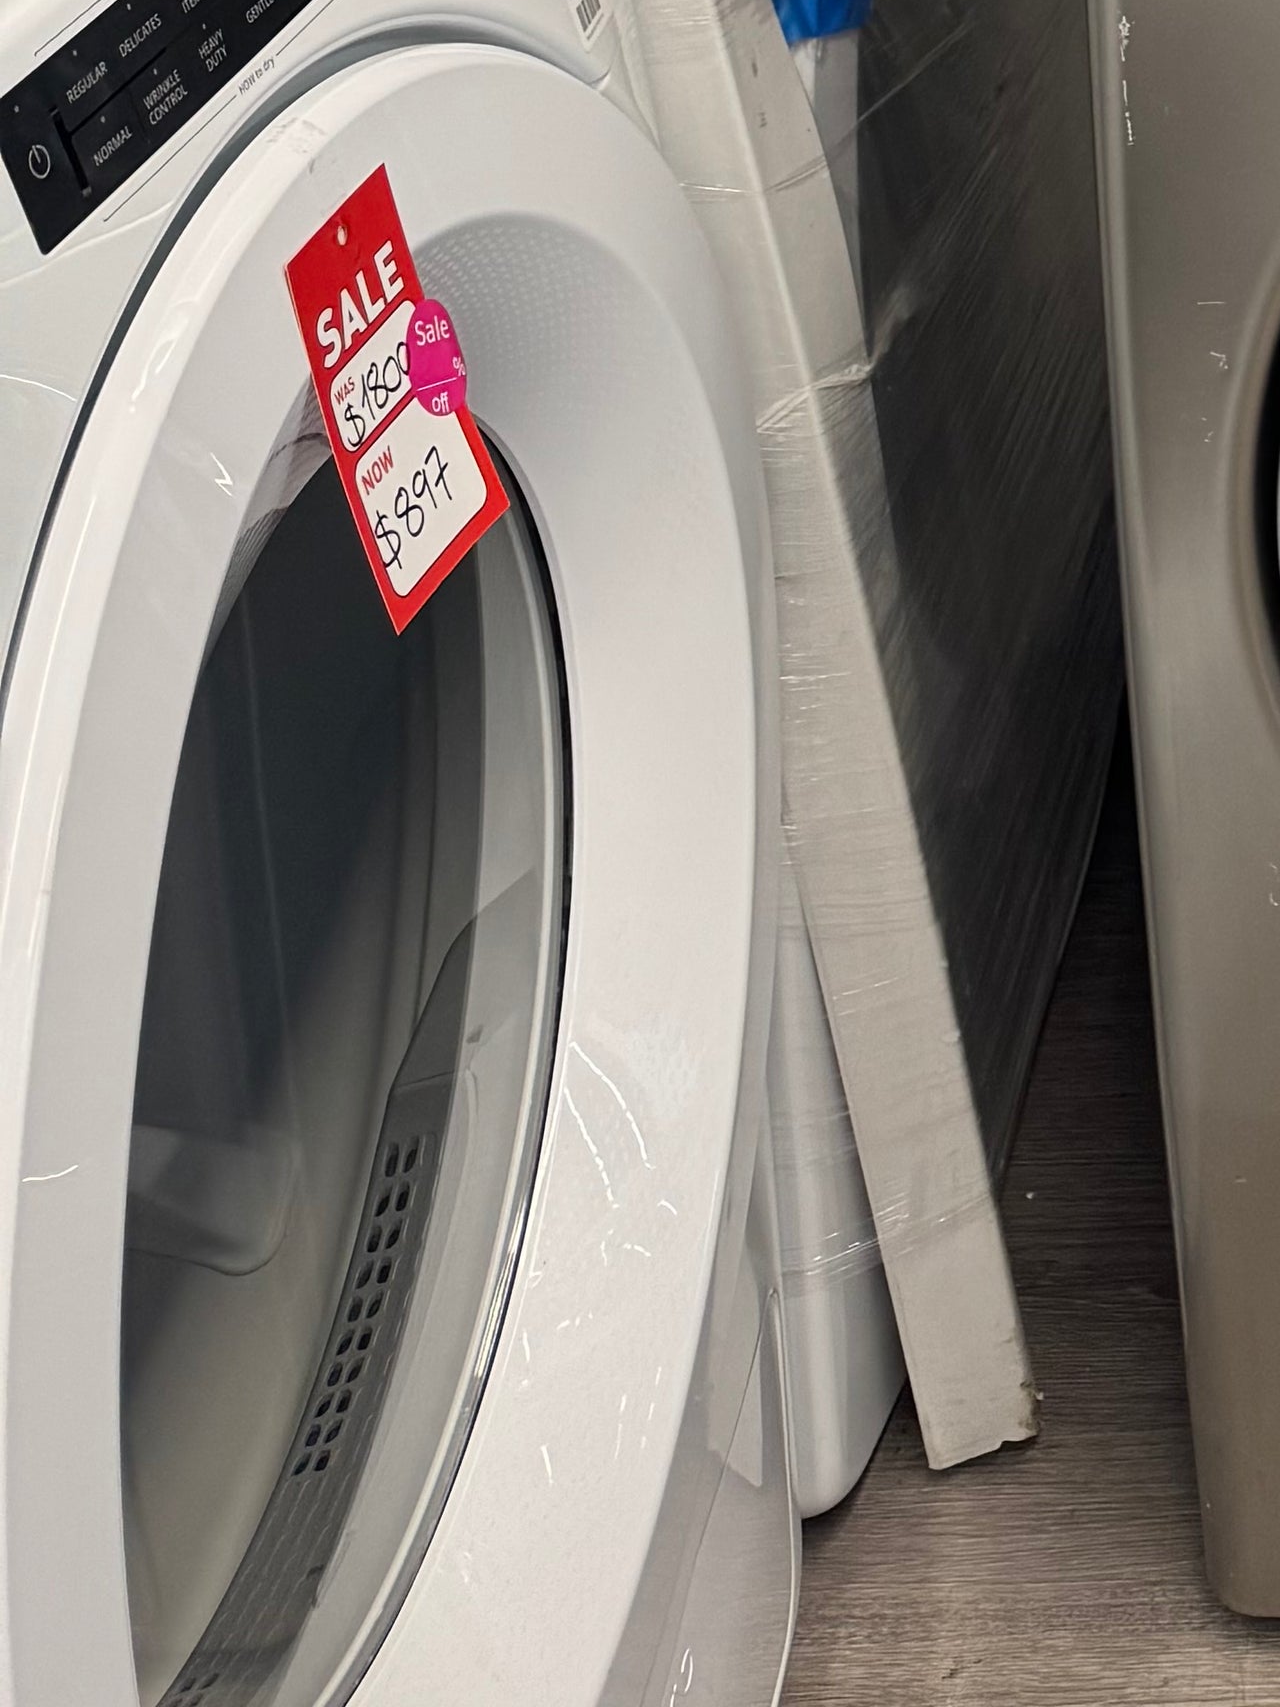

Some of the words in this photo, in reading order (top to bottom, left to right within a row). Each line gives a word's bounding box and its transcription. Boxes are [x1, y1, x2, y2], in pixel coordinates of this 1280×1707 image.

[119, 13, 162, 58] DELICATES
[198, 29, 224, 60] HEAVY
[206, 45, 227, 72] DUTY
[66, 61, 108, 104] REGULAR
[143, 69, 181, 110] WRINKLE
[149, 85, 188, 125] CONTROL
[93, 126, 133, 166] NORMAL
[316, 239, 404, 369] SALE
[415, 317, 450, 346] Sale
[453, 356, 465, 377] %
[334, 377, 355, 405] WAS
[345, 341, 411, 447] $1800
[432, 395, 449, 413] Off
[361, 457, 394, 495] NOW
[374, 446, 453, 569] $897
